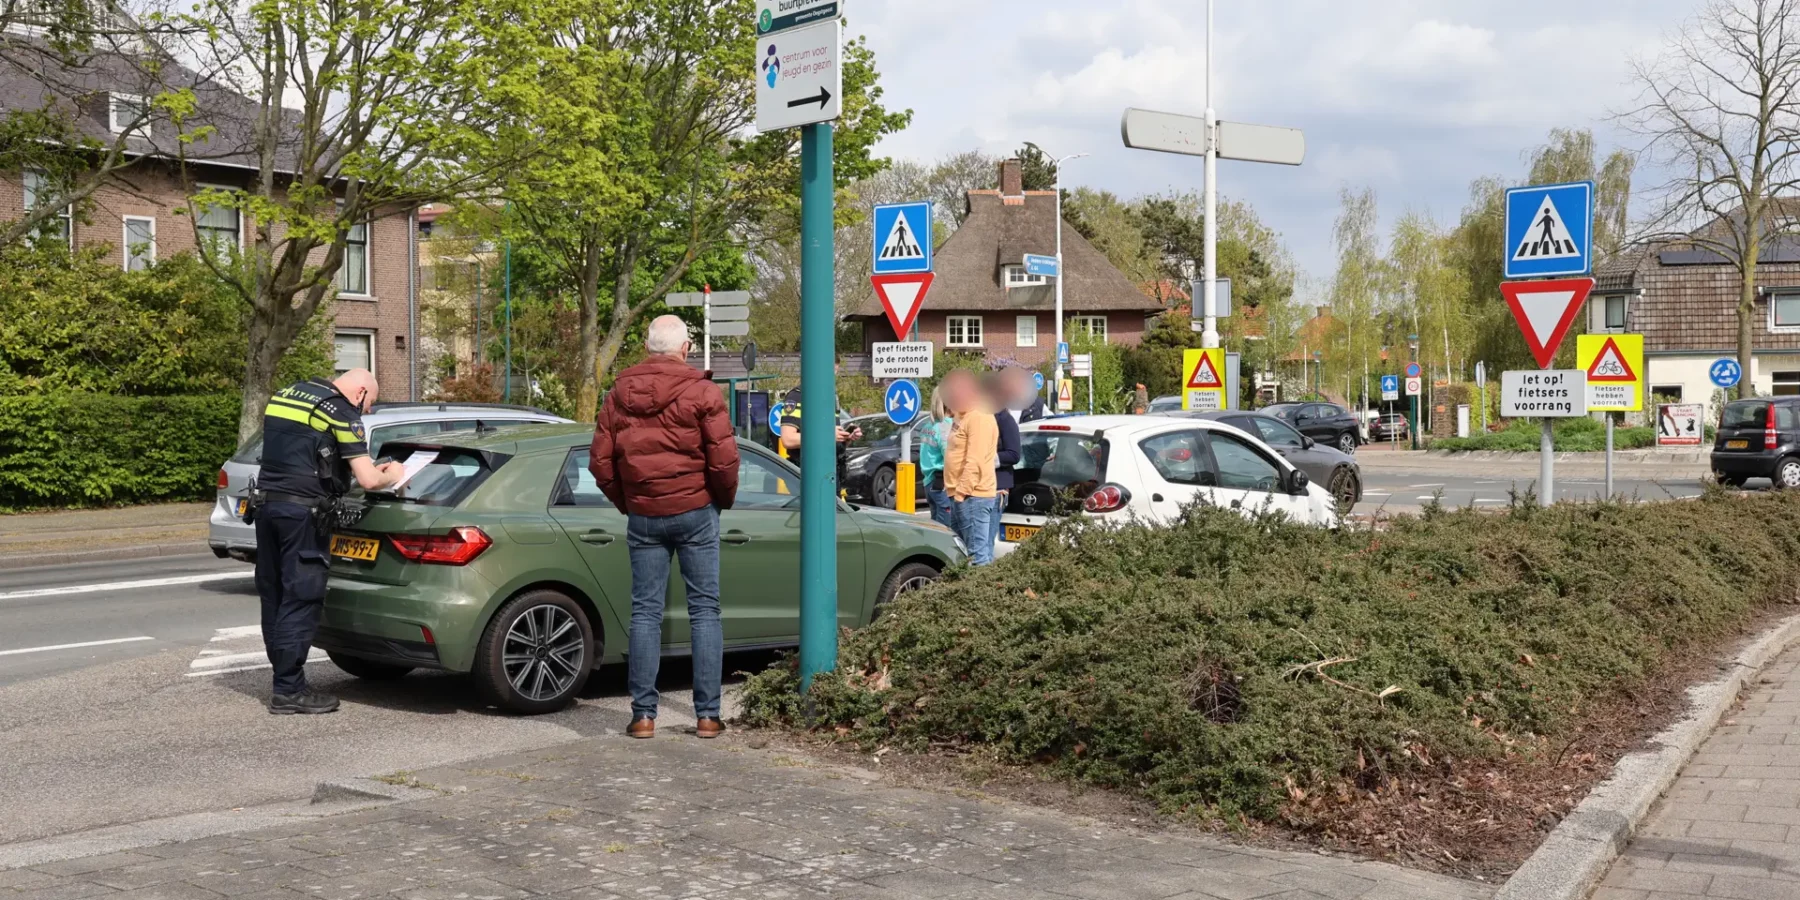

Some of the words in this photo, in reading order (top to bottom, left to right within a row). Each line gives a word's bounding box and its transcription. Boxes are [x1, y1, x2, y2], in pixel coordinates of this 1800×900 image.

[782, 51, 810, 63] centrum
[812, 46, 827, 56] voor
[782, 64, 801, 81] jeugd
[802, 64, 811, 73] en
[813, 58, 831, 74] gezin
[877, 345, 893, 354] geef
[884, 367, 919, 375] voorrang
[1523, 374, 1539, 384] let
[1544, 373, 1563, 386] op!
[1518, 387, 1568, 398] fietsers
[1514, 401, 1571, 413] voorrang
